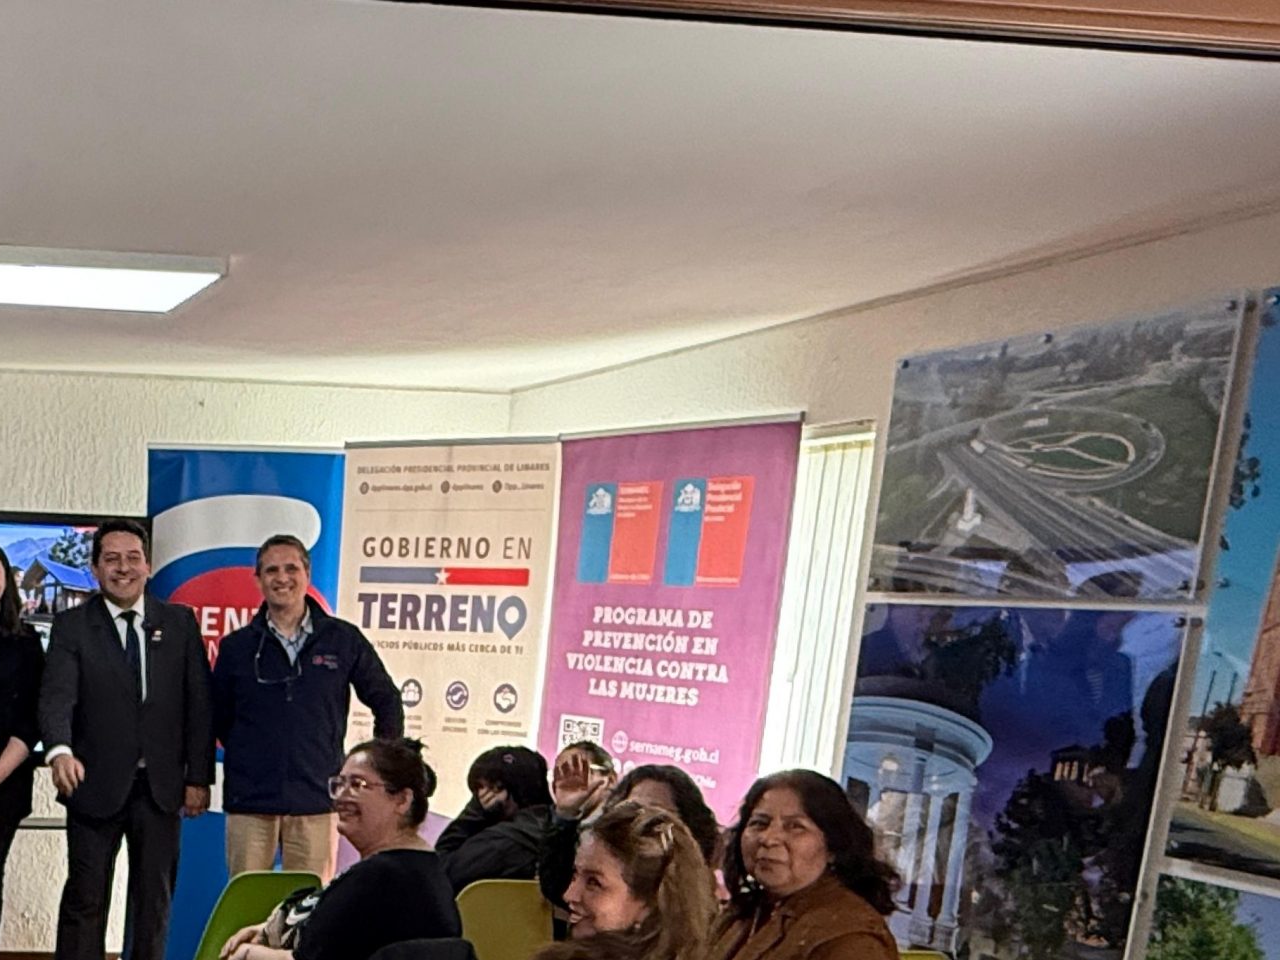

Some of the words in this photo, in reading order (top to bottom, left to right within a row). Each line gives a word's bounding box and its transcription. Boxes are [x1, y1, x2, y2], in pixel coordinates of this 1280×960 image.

[363, 536, 490, 559] GOBIERNO
[503, 537, 532, 560] EN
[358, 592, 527, 640] TERRENO
[593, 606, 684, 628] PROGRAMA
[687, 610, 714, 629] DE
[373, 640, 400, 649] ICIOS
[402, 640, 444, 651] PÚBLICOS
[447, 641, 466, 652] MÁS
[469, 644, 497, 653] CERCA
[500, 645, 511, 654] DE
[514, 646, 524, 655] TI
[582, 630, 689, 653] PREVENCIÓN
[691, 637, 719, 656] EN
[566, 653, 653, 676] VIOLENCIA
[656, 660, 728, 683] CONTRA
[588, 678, 618, 697] LAS
[619, 681, 700, 706] MUJERES
